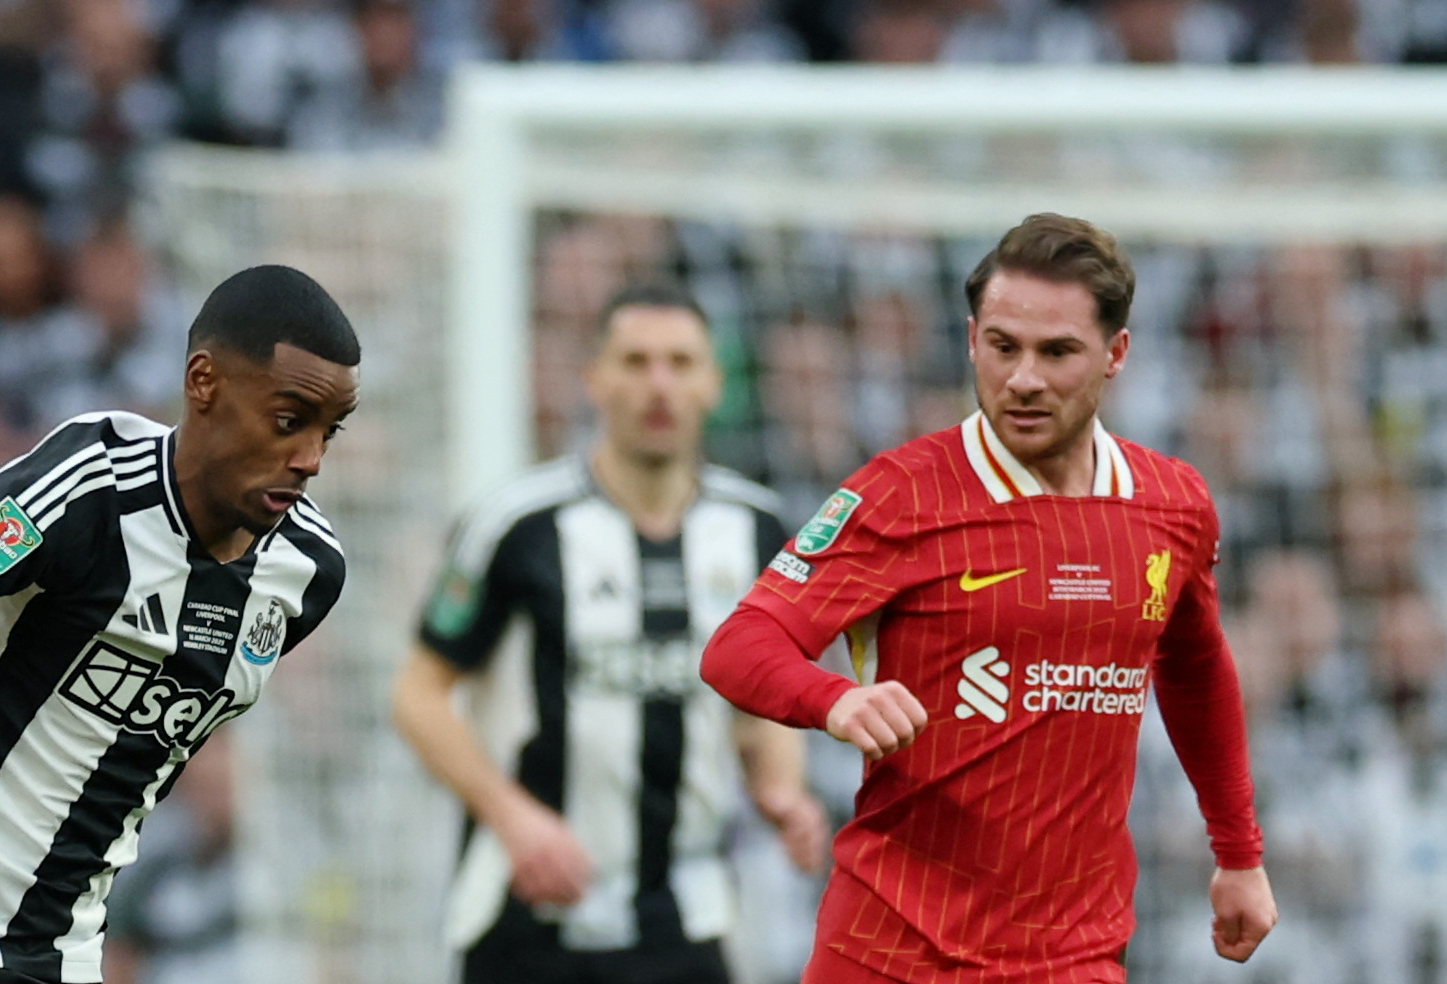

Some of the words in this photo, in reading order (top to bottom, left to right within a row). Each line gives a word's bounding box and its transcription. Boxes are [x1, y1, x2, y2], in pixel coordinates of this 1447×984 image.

[1142, 602, 1167, 622] LFC
[1024, 659, 1149, 689] standard
[1022, 687, 1145, 715] chartered
